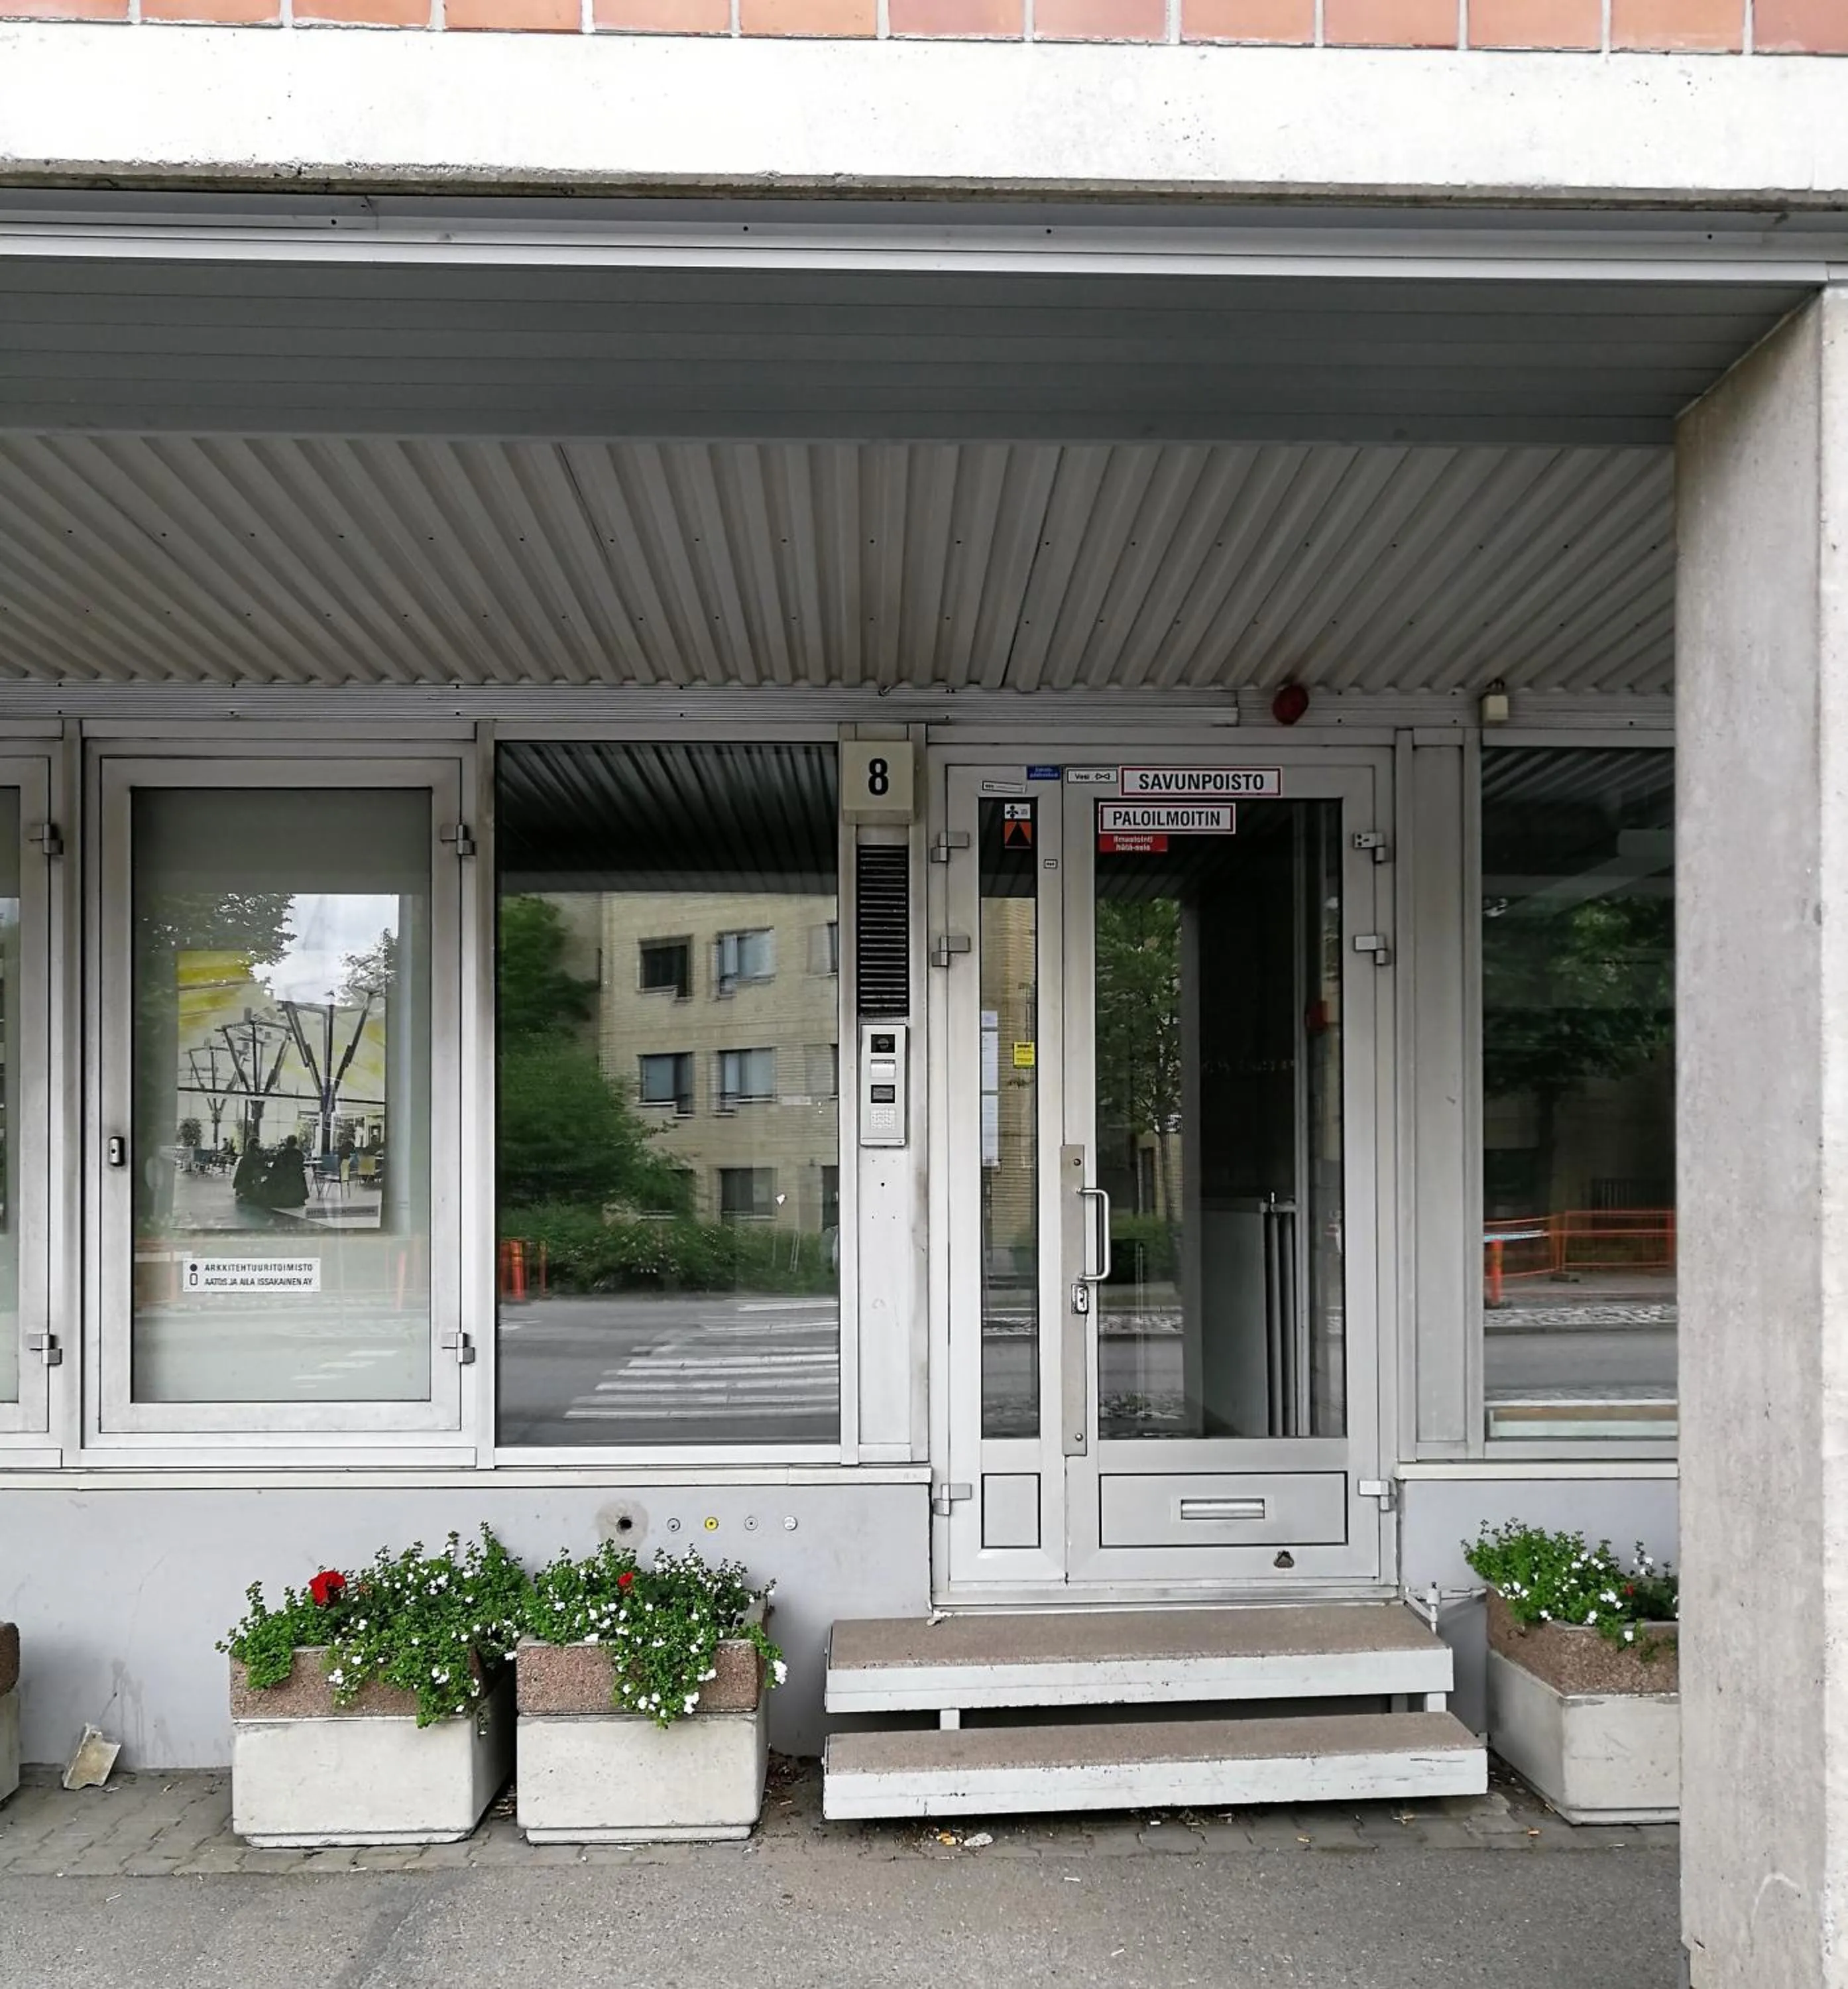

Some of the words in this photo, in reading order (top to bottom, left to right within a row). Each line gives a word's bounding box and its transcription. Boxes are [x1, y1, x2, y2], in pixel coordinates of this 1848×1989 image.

[868, 758, 889, 796] 8
[1138, 773, 1264, 790] SAVUNPOISTO
[1112, 810, 1220, 826] PALOILMOITIN
